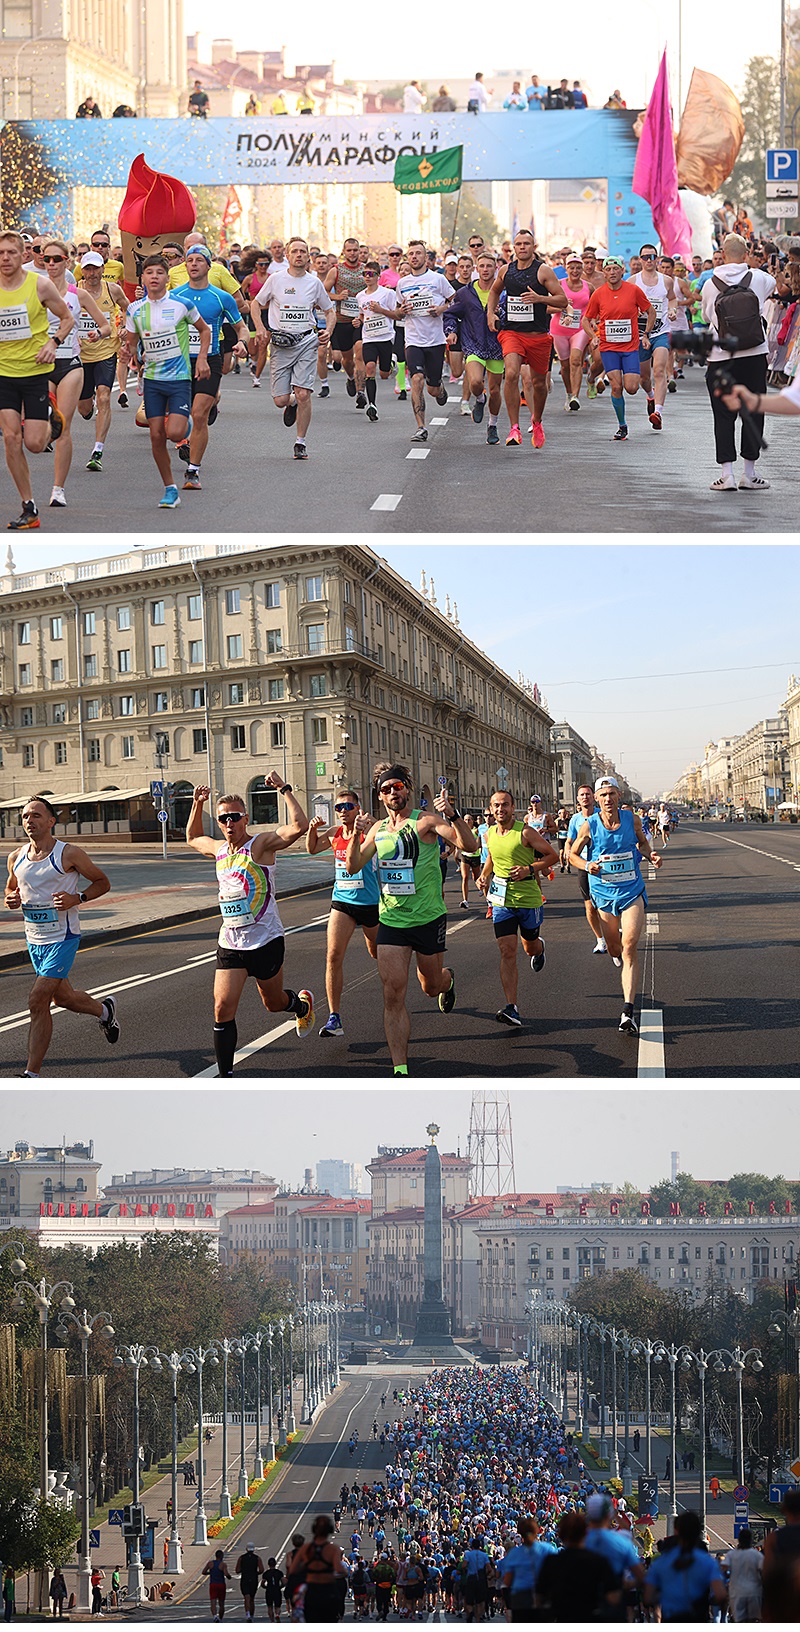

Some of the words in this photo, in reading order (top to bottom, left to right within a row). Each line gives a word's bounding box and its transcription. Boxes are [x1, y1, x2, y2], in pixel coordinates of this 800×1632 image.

[318, 129, 439, 142] МИНСКИЙ
[773, 152, 792, 178] P
[149, 340, 172, 350] 11225
[609, 863, 625, 871] 1171
[386, 872, 402, 880] 845
[223, 904, 242, 914] 2325
[29, 912, 48, 921] 1572
[39, 1203, 102, 1217] ПОДВИГ
[119, 1203, 214, 1217] НАРОДА
